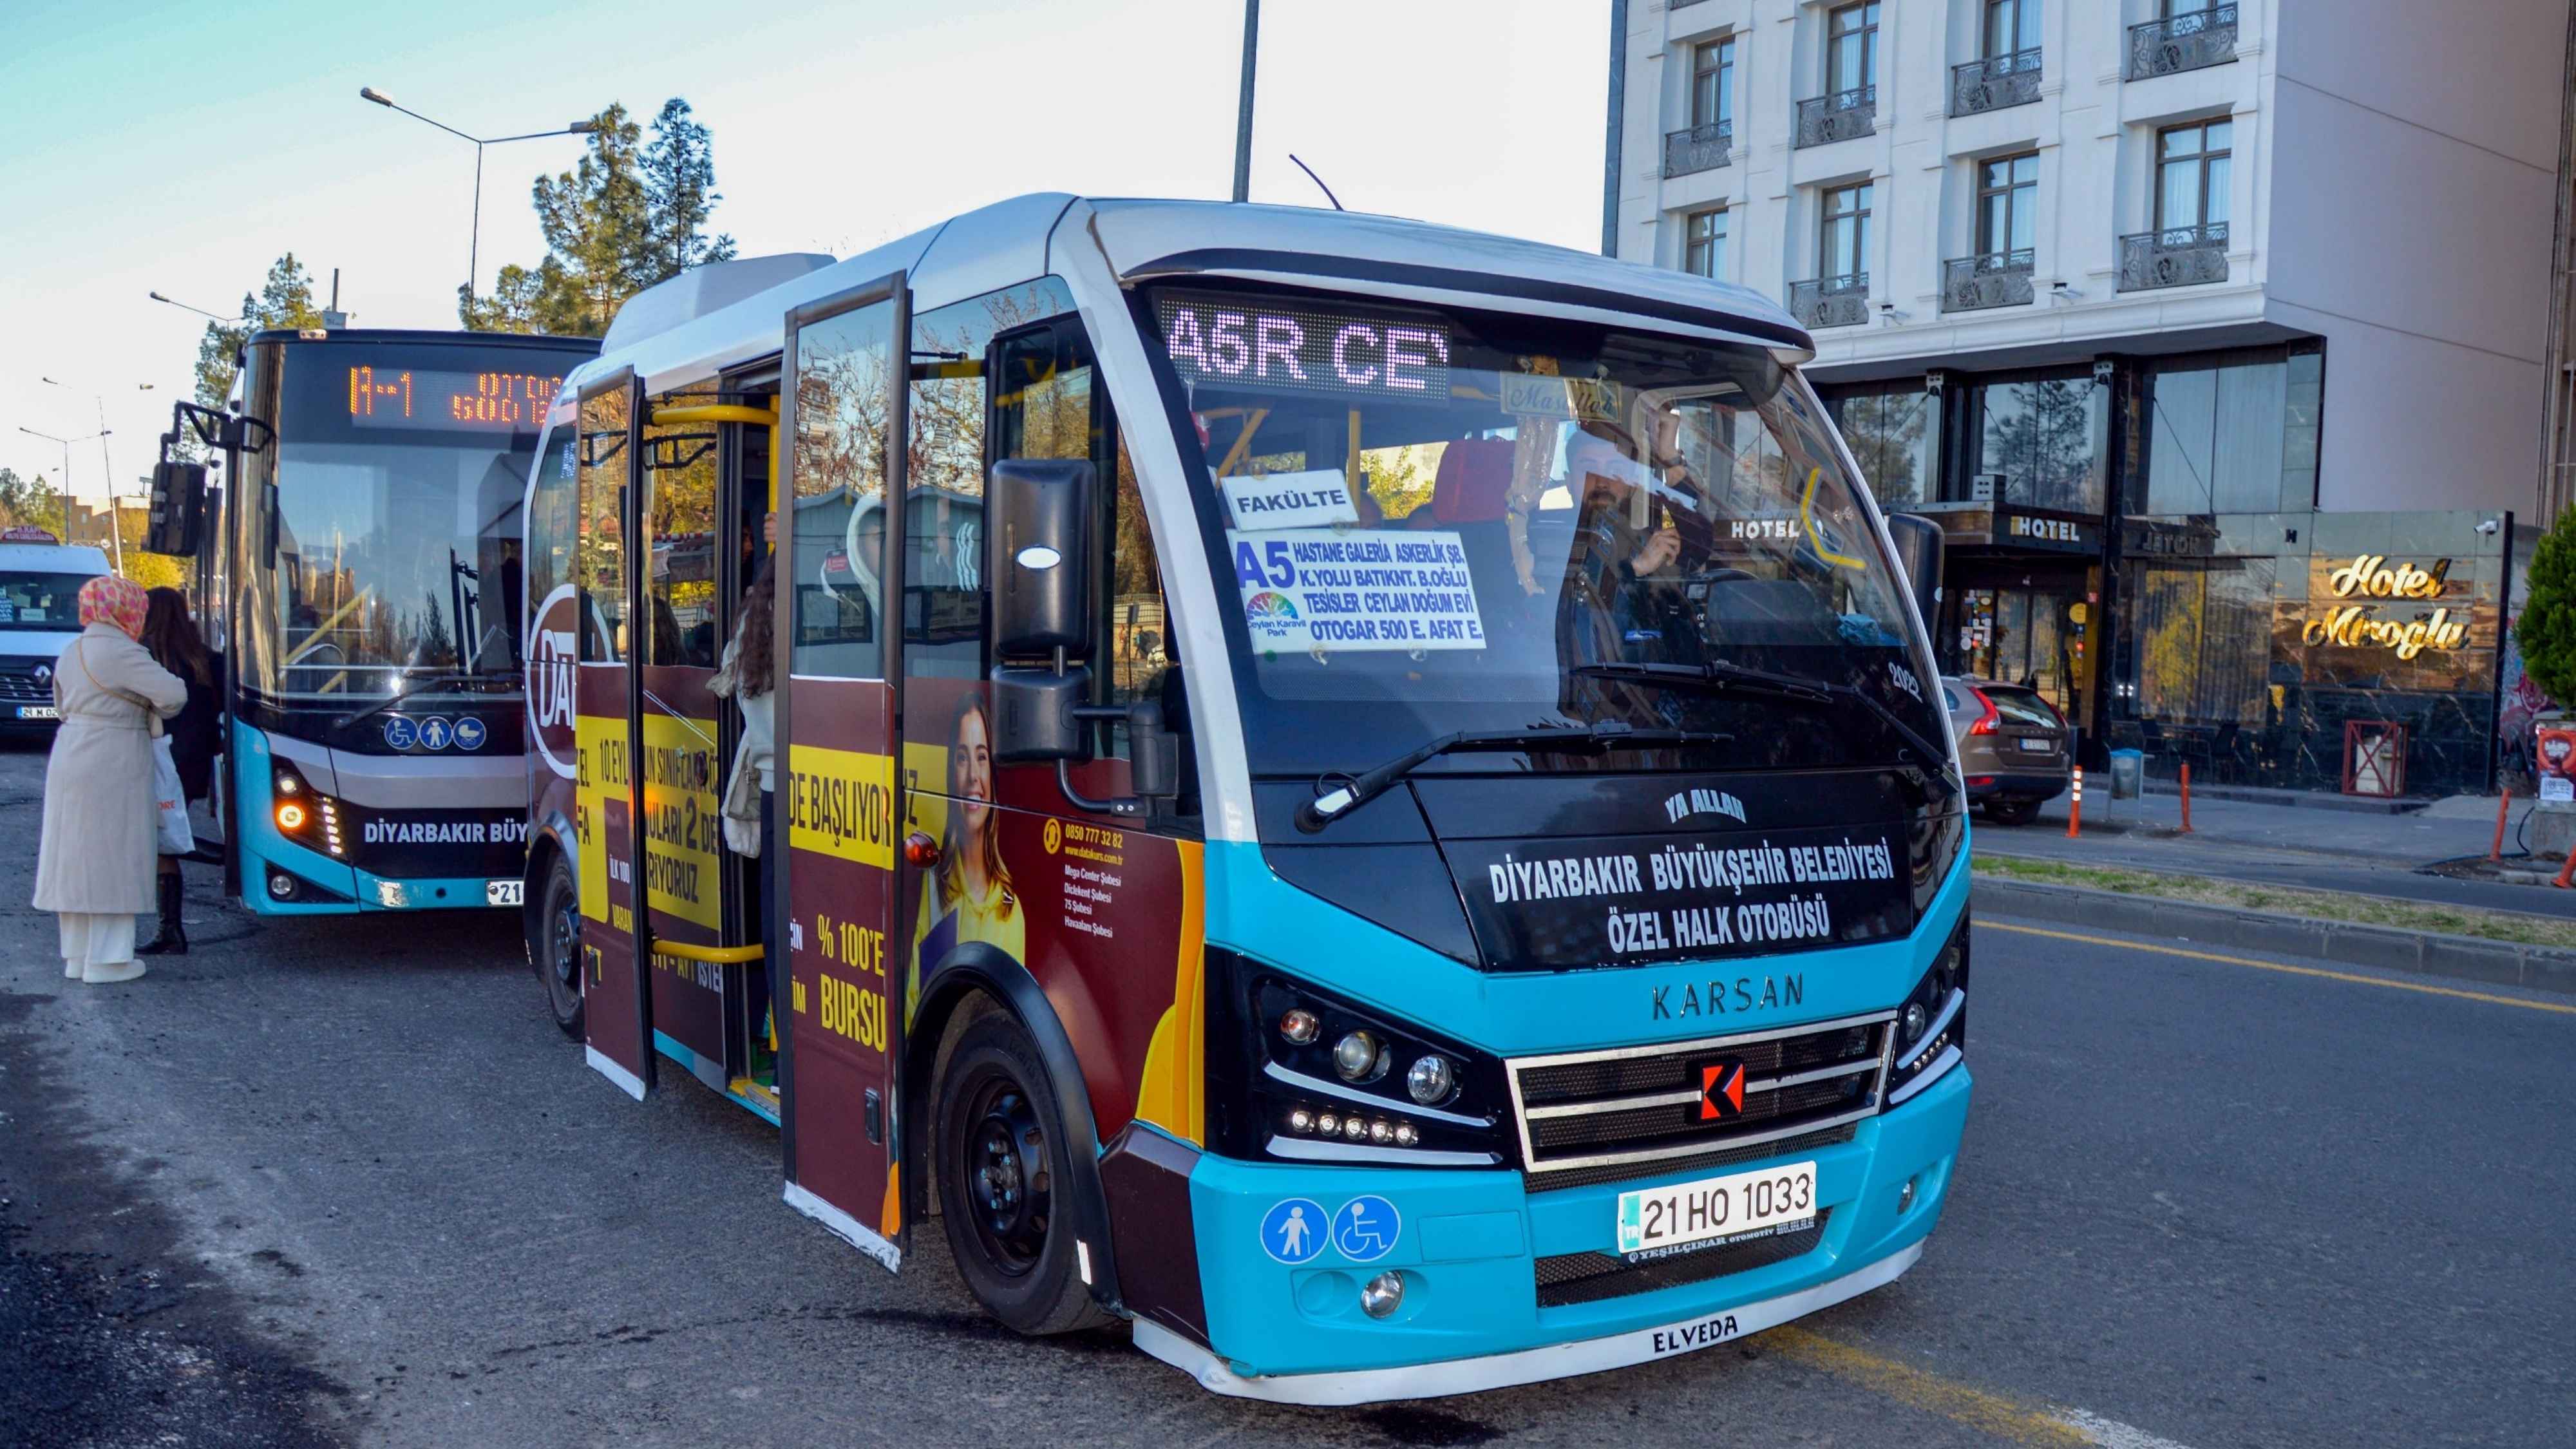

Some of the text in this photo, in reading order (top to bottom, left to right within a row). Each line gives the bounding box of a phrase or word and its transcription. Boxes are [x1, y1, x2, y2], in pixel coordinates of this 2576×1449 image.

[1169, 309, 1307, 380] A5R
[1236, 489, 1346, 513] FAKÜLTE
[1731, 520, 1800, 539] HOTEL
[2012, 516, 2080, 542] HOTEL
[1236, 541, 1296, 589] A5
[1293, 538, 1465, 569] HASTANE GALERİA ASKERLİK ŞB.
[1300, 567, 1468, 587] K.YOLU BATIKNT. B.OĞLU
[2330, 554, 2452, 598] Hotel
[1303, 588, 1474, 613] TESİSLER CEYLAN DOĞUM EVİ
[1311, 620, 1379, 640] OTOGAR
[1379, 620, 1408, 639] 500
[1409, 620, 1426, 639] E.
[1429, 620, 1464, 639] AFAT
[1888, 661, 1923, 703] 2022
[600, 739, 611, 782] 10
[811, 774, 891, 848] BAŞLIYOR
[1665, 789, 1747, 824] YA ALLAH
[365, 818, 485, 843] DİYARBAKIR
[686, 796, 697, 850] 2
[1065, 824, 1123, 849] 0850 777 32 82
[620, 860, 630, 884] 100
[1080, 867, 1100, 882] Center
[1100, 871, 1122, 887] Şubesi
[1489, 837, 1895, 903] DİYARBAKIR BÜYÜKŞEHİR BELEDİYESİ
[500, 884, 520, 903] 21
[1064, 898, 1092, 915] 75 Şubesi
[1091, 888, 1112, 904] Şubesi
[817, 913, 835, 959] %
[1092, 922, 1113, 938] Şubesi
[1608, 893, 1830, 954] ÖZEL HALK OTOBÜSÜ
[1653, 972, 1803, 1021] KARSAN
[820, 973, 887, 1053] BURSU
[1644, 1196, 1677, 1240] 21
[1743, 1173, 1810, 1220] 1033
[1625, 1226, 1640, 1239] TR
[1640, 1228, 1775, 1260] YEŞİLÇINAR OTOMOTİV
[1653, 1315, 1738, 1353] ELVEDA
